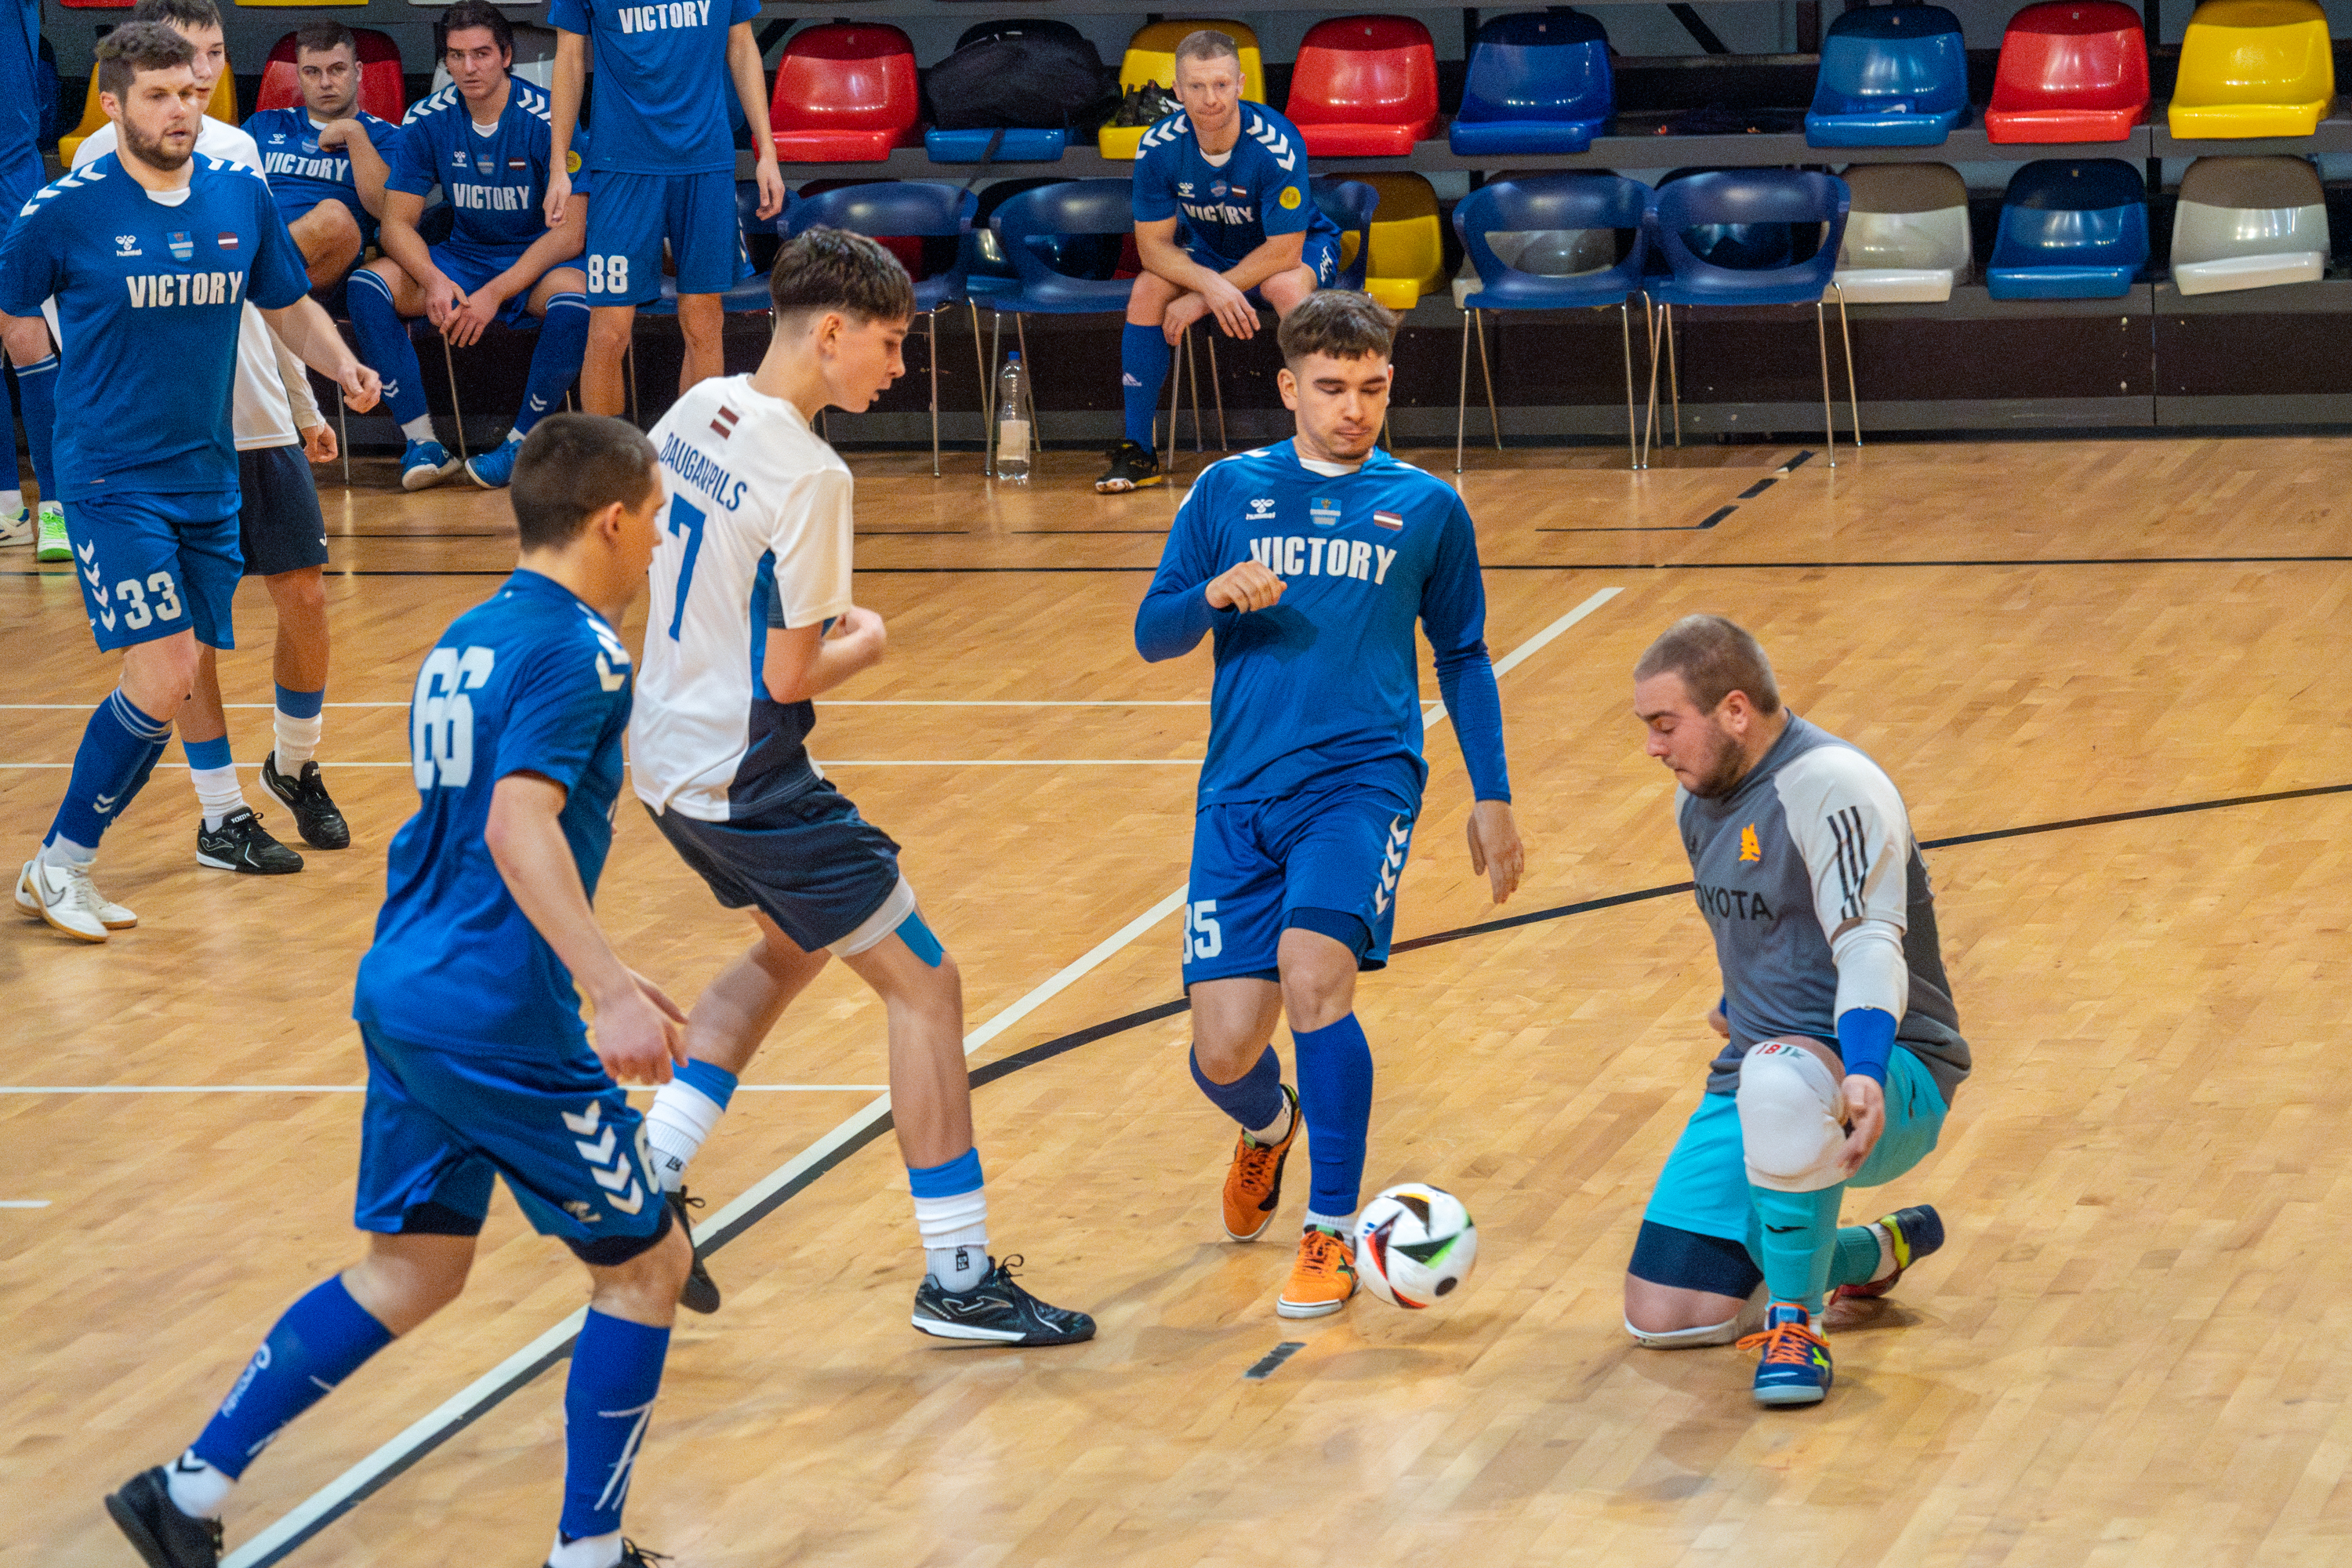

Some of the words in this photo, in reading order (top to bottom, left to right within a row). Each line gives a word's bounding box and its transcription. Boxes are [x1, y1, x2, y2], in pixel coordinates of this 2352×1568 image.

[618, 0, 711, 34] VICTORY
[264, 152, 350, 182] VICTORY
[452, 183, 530, 210] VICTORY
[125, 270, 243, 308] VICTORY
[588, 254, 628, 294] 88
[668, 492, 707, 643] 7
[1250, 535, 1397, 585] VICTORY
[115, 570, 182, 630] 33
[412, 645, 495, 790] 66
